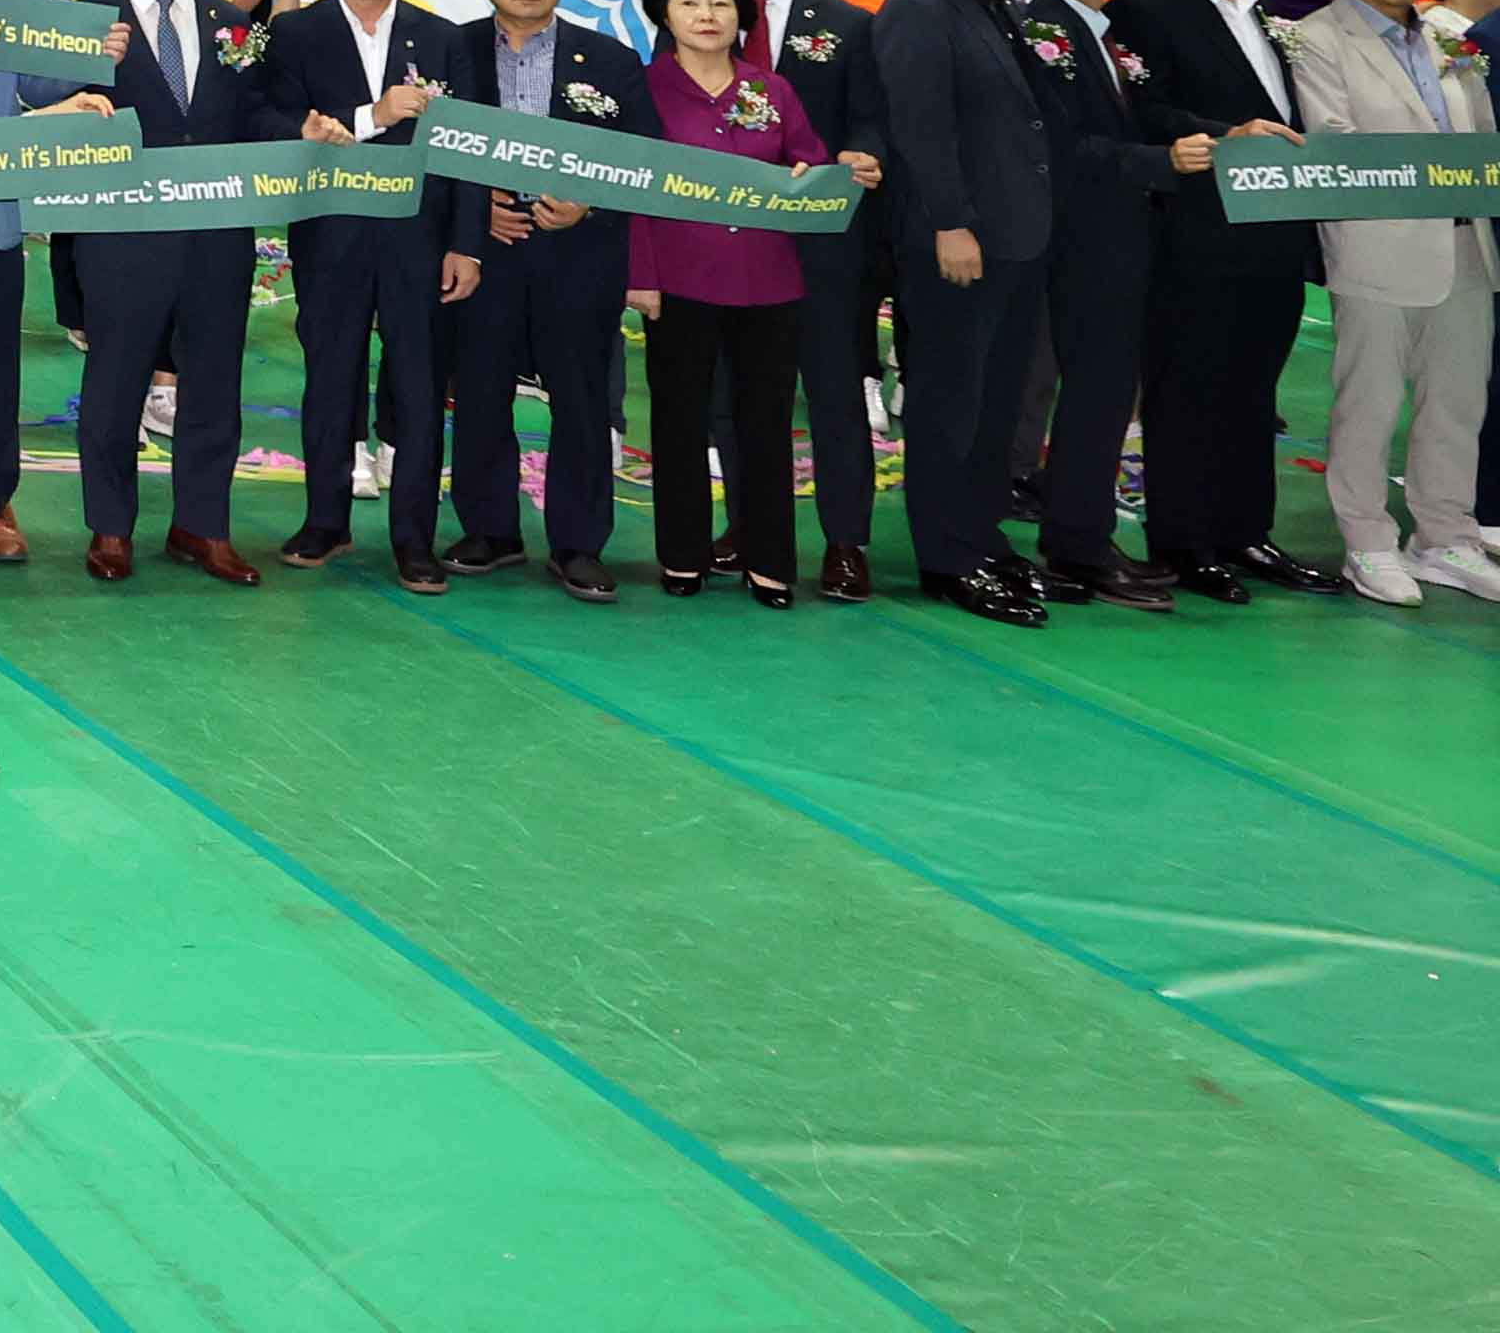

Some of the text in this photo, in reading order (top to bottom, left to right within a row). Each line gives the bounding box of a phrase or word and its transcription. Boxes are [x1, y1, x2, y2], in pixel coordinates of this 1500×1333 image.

[22, 24, 102, 55] Incheon
[21, 143, 51, 169] it's
[54, 143, 132, 168] Incheon
[429, 126, 489, 156] 2025
[492, 138, 555, 171] APEC
[559, 151, 655, 190] Summit
[727, 183, 763, 209] it's
[765, 192, 849, 214] Incheon
[158, 180, 243, 203] Summit
[306, 167, 329, 193] it's
[332, 168, 415, 195] Incheon
[1228, 166, 1290, 191] 2025
[1293, 167, 1338, 189] APEC
[1339, 166, 1418, 190] Summit
